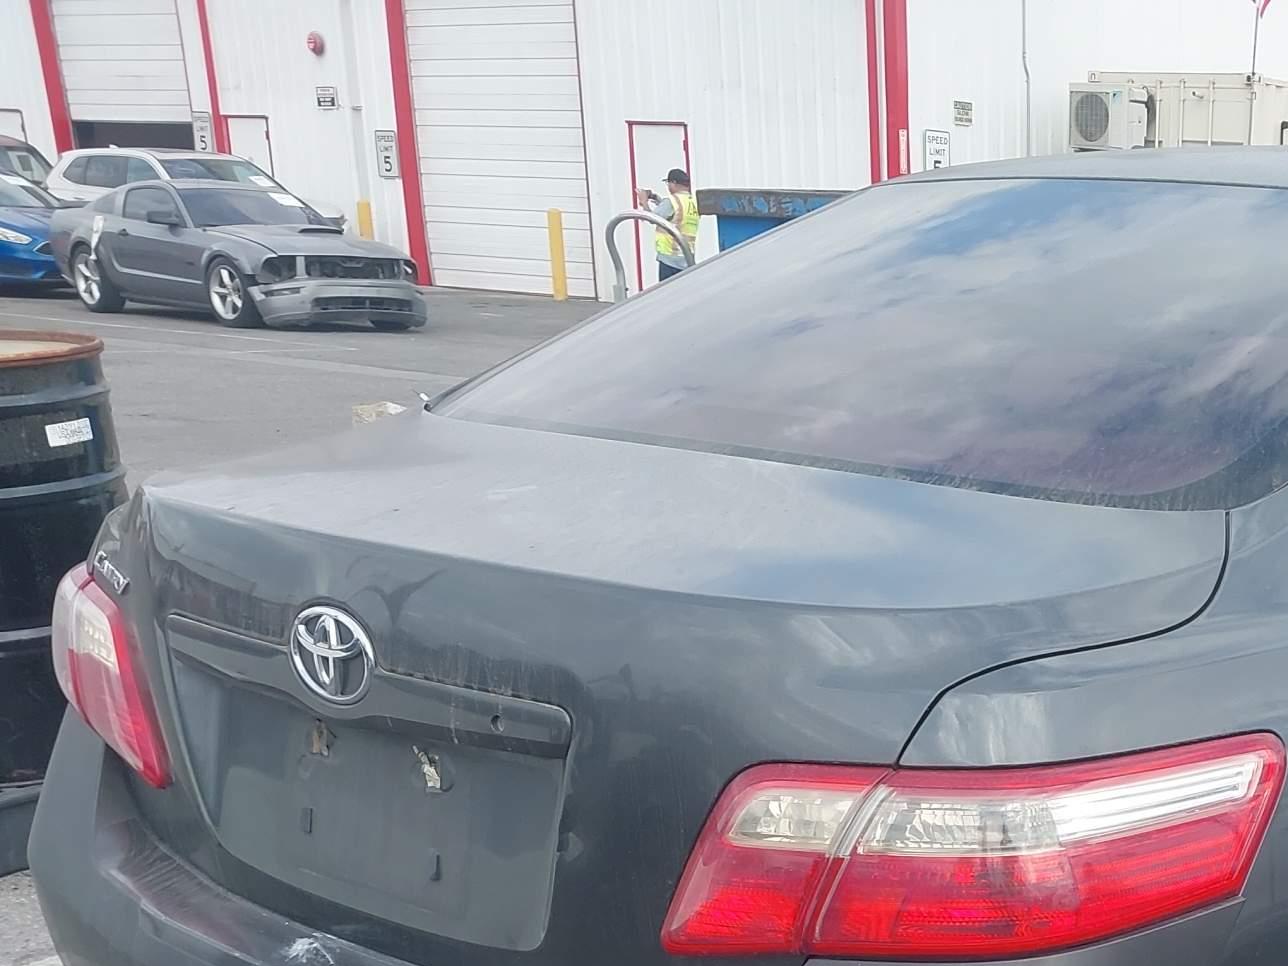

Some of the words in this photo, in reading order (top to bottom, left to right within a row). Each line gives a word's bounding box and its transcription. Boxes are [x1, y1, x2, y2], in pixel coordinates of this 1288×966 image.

[199, 134, 208, 151] 5
[927, 135, 948, 145] SPEED
[929, 147, 946, 156] LIMIT
[383, 155, 393, 172] 5
